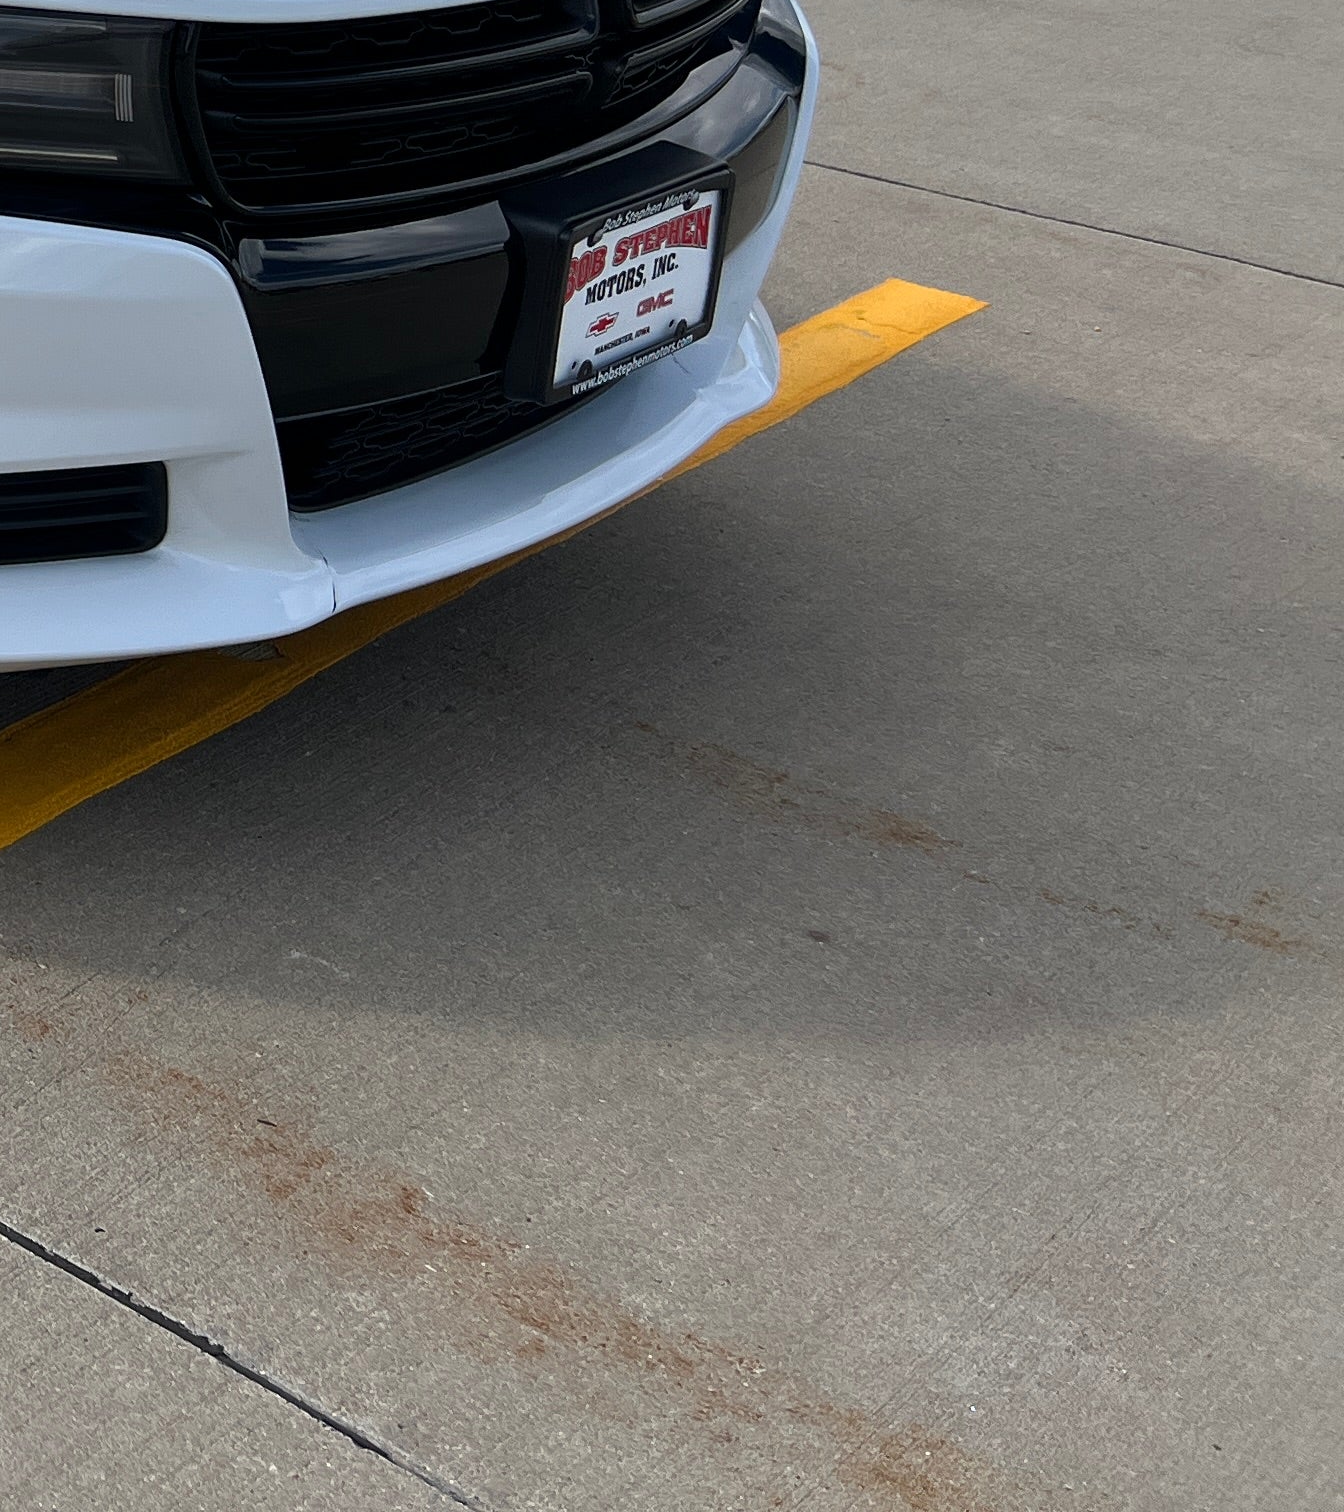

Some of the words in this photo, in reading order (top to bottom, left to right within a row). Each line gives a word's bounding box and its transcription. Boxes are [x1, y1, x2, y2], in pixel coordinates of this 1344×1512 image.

[602, 213, 623, 233] Bob
[622, 201, 663, 226] Stephen
[564, 245, 608, 304] BOB
[612, 204, 712, 267] STEPHEN
[585, 263, 647, 305] MOTORS,
[651, 252, 679, 281] INC.
[636, 288, 675, 318] GMC
[571, 333, 694, 395] www.bobstephenmotors.com
